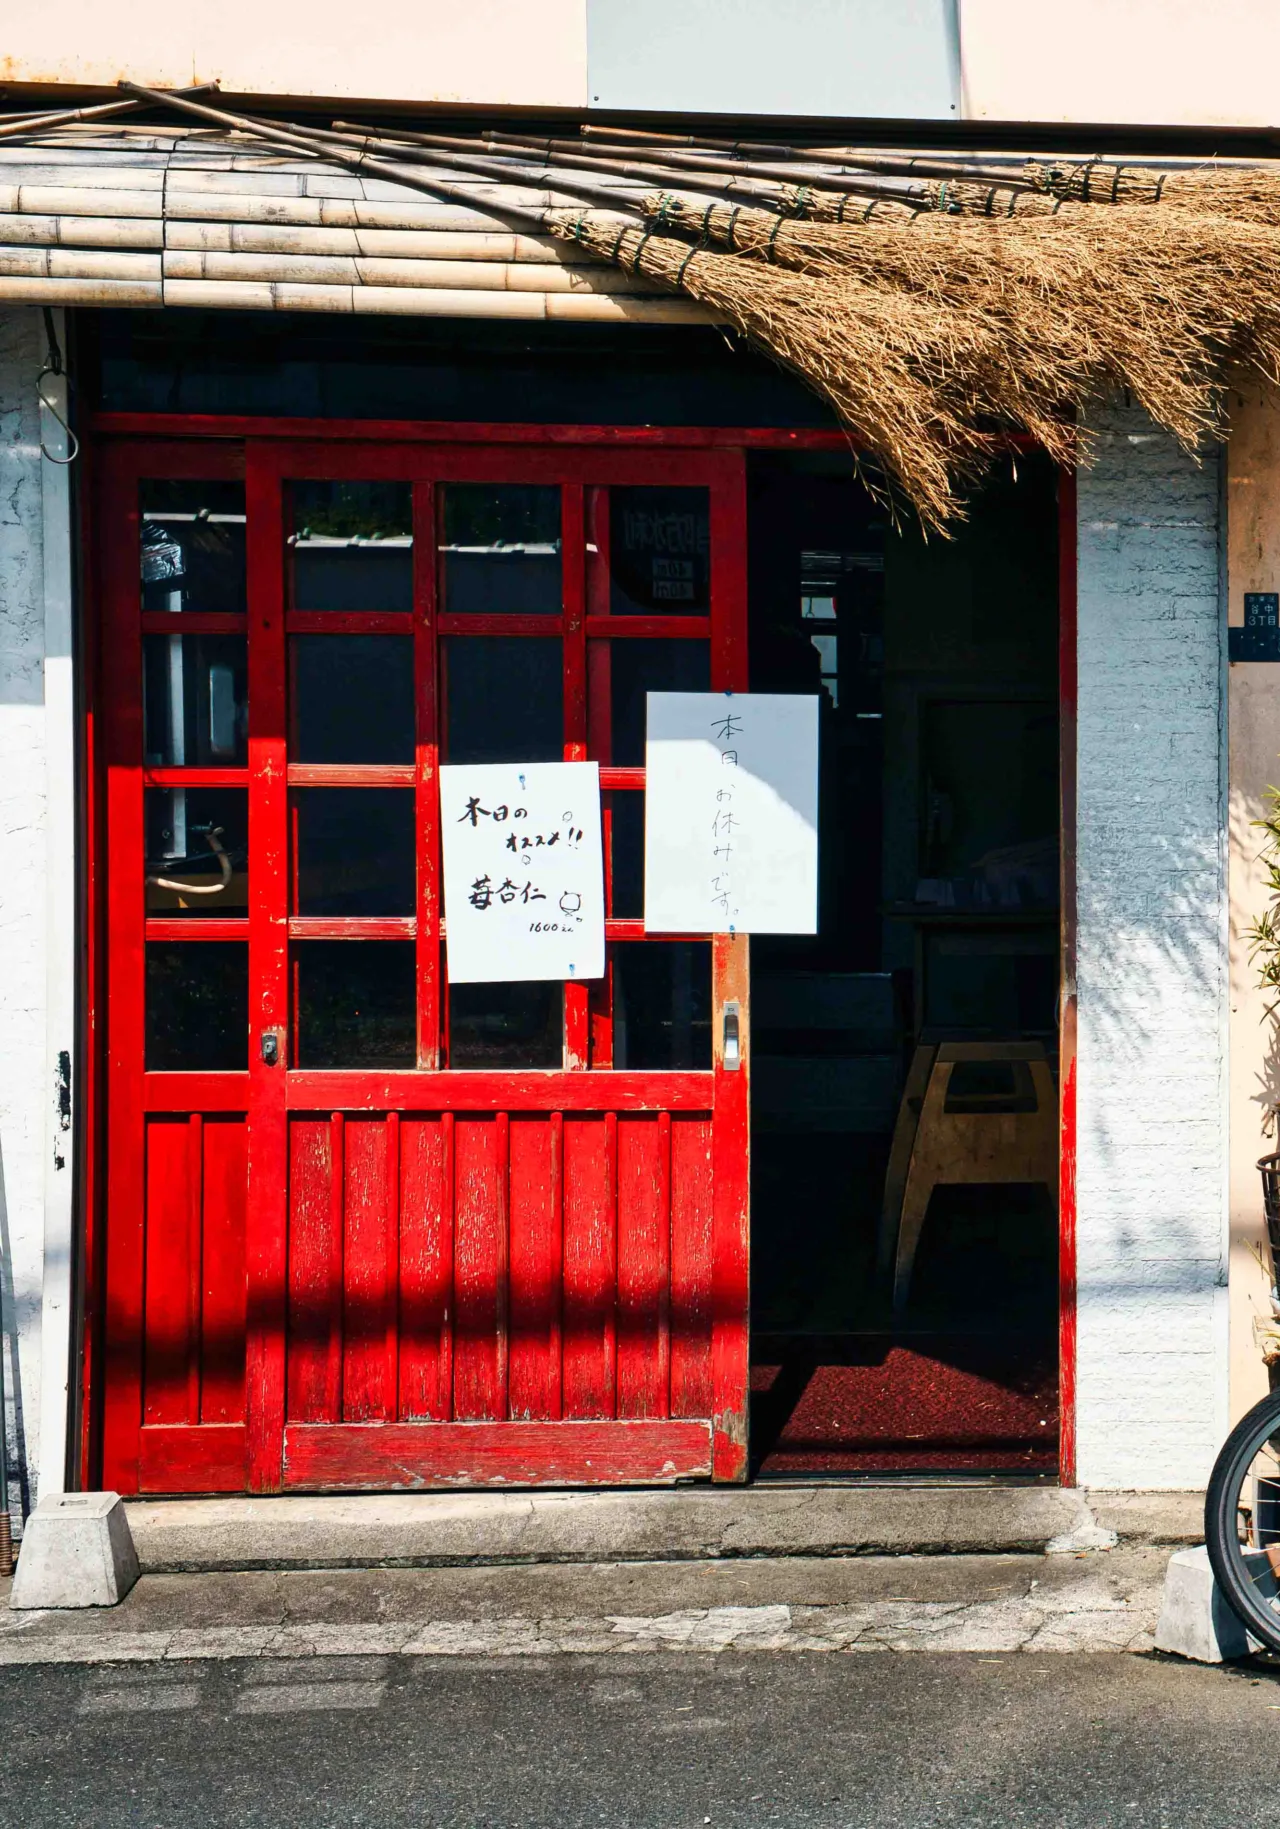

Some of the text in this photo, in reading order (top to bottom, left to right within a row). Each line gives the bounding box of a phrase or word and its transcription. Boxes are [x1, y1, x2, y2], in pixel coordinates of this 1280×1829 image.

[1248, 615, 1276, 626] 3丁目
[457, 796, 528, 827] 本日の
[468, 874, 547, 910] 苺杏仁
